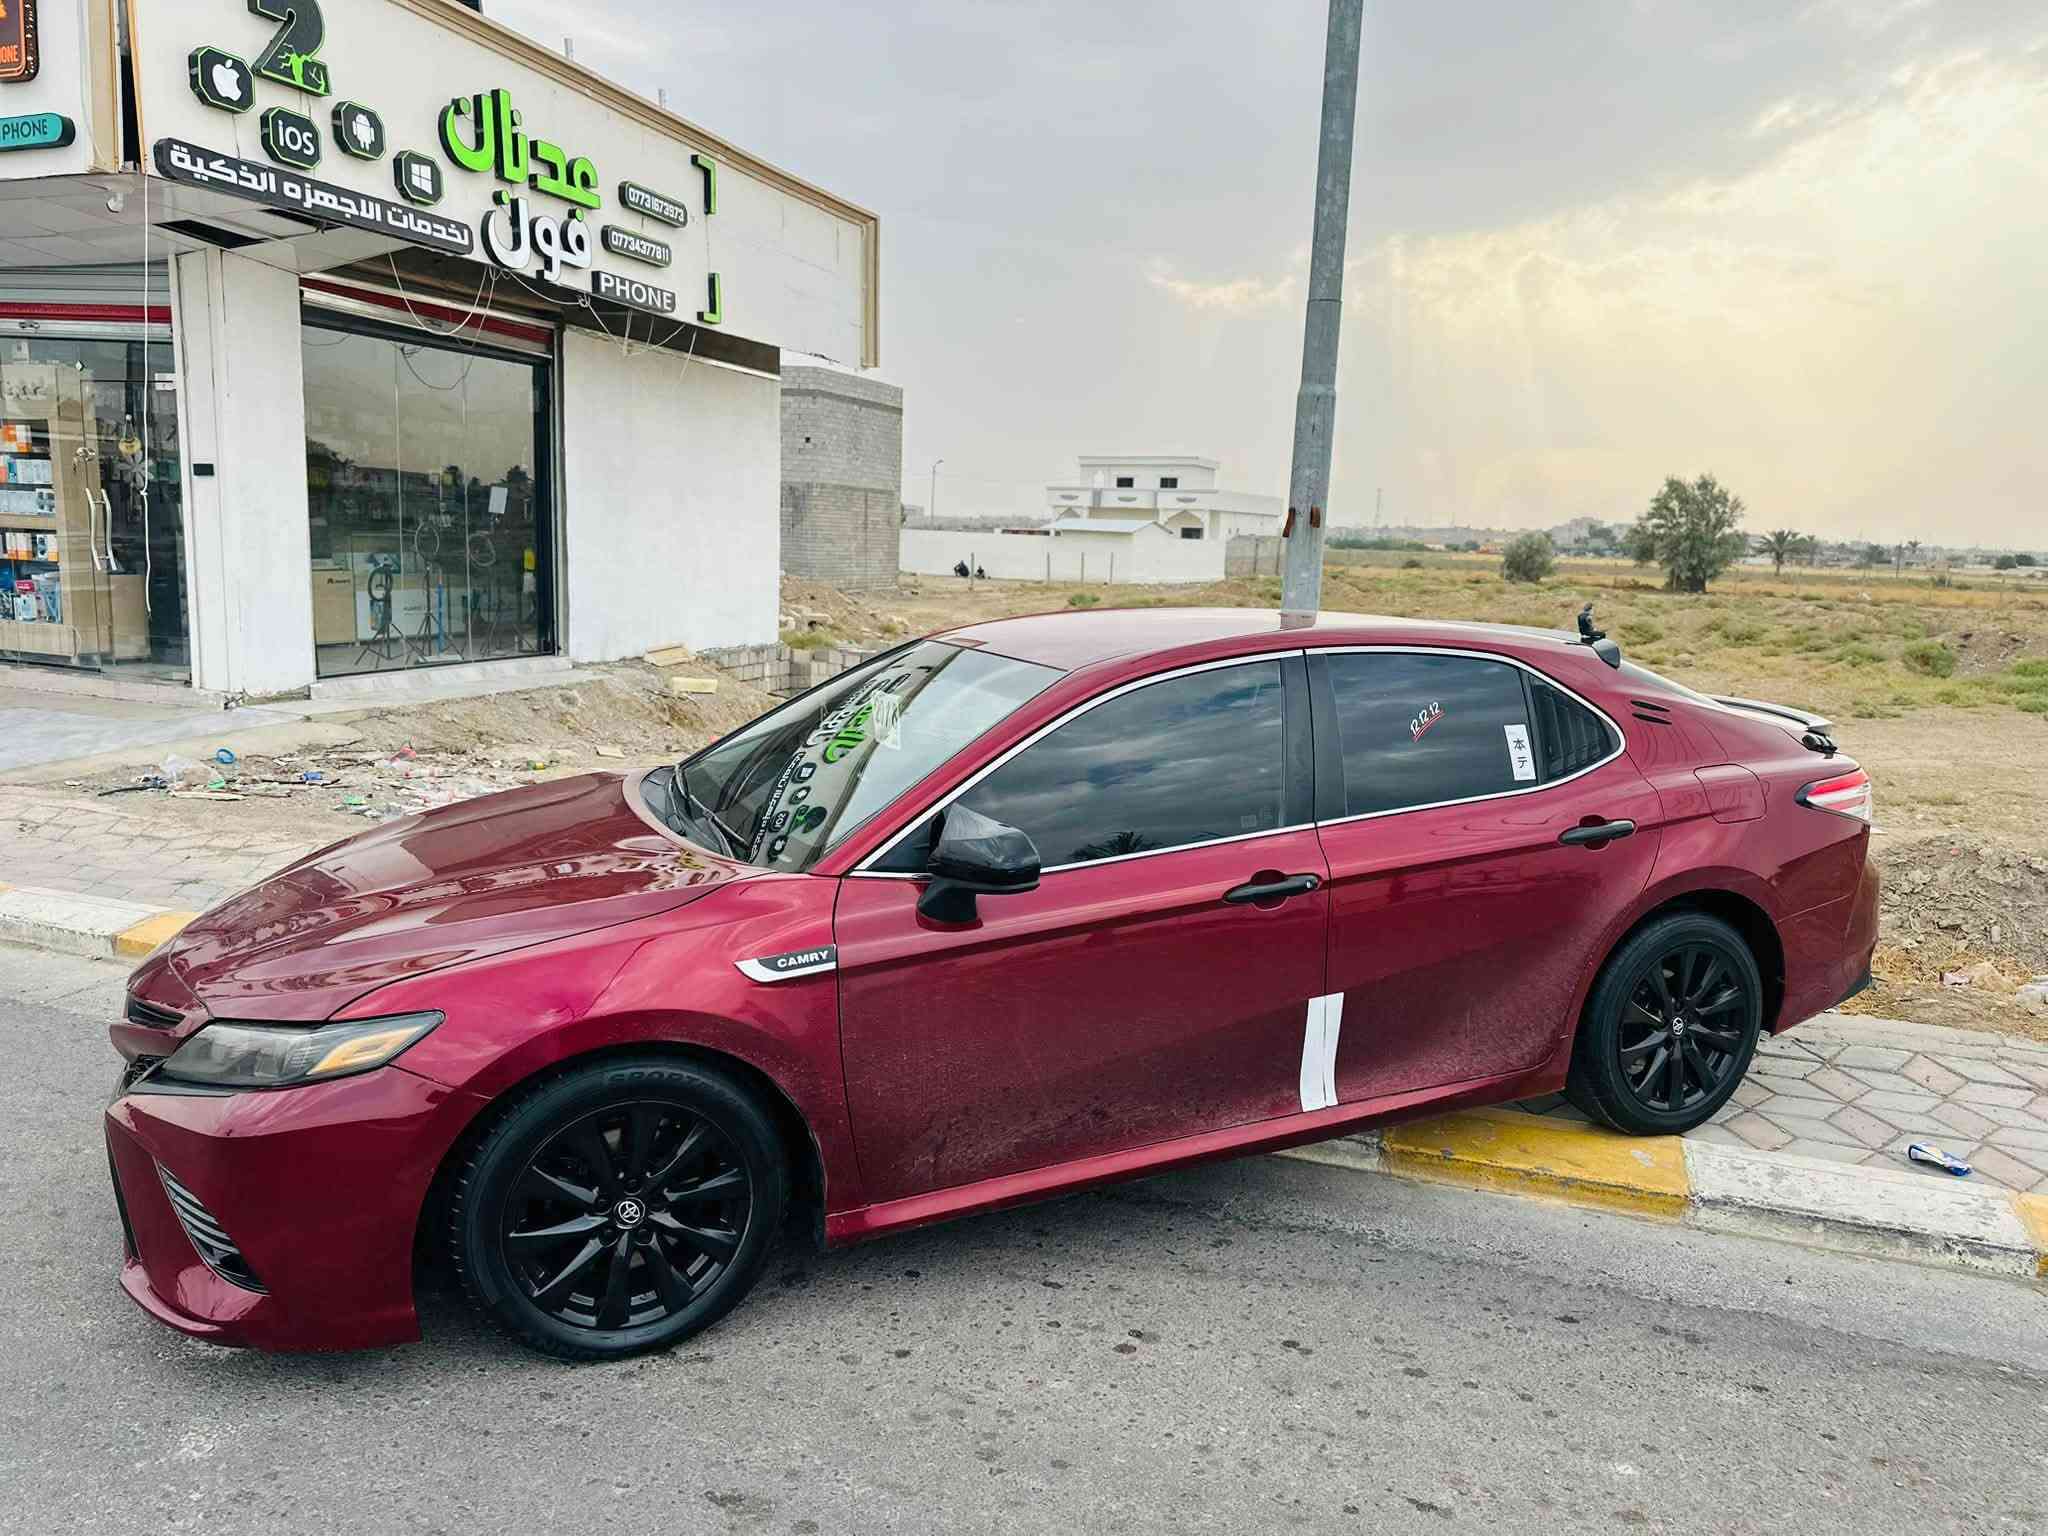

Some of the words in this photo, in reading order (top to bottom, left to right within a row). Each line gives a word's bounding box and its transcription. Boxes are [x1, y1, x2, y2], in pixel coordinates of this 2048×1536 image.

[2, 118, 48, 140] PHONE
[277, 118, 316, 156] iOS
[438, 88, 602, 209] عدنان
[169, 144, 277, 193] الذكية
[482, 189, 593, 282] فون
[611, 231, 670, 262] 07734377811
[600, 272, 673, 312] PHONE
[776, 950, 830, 969] CAMRY
